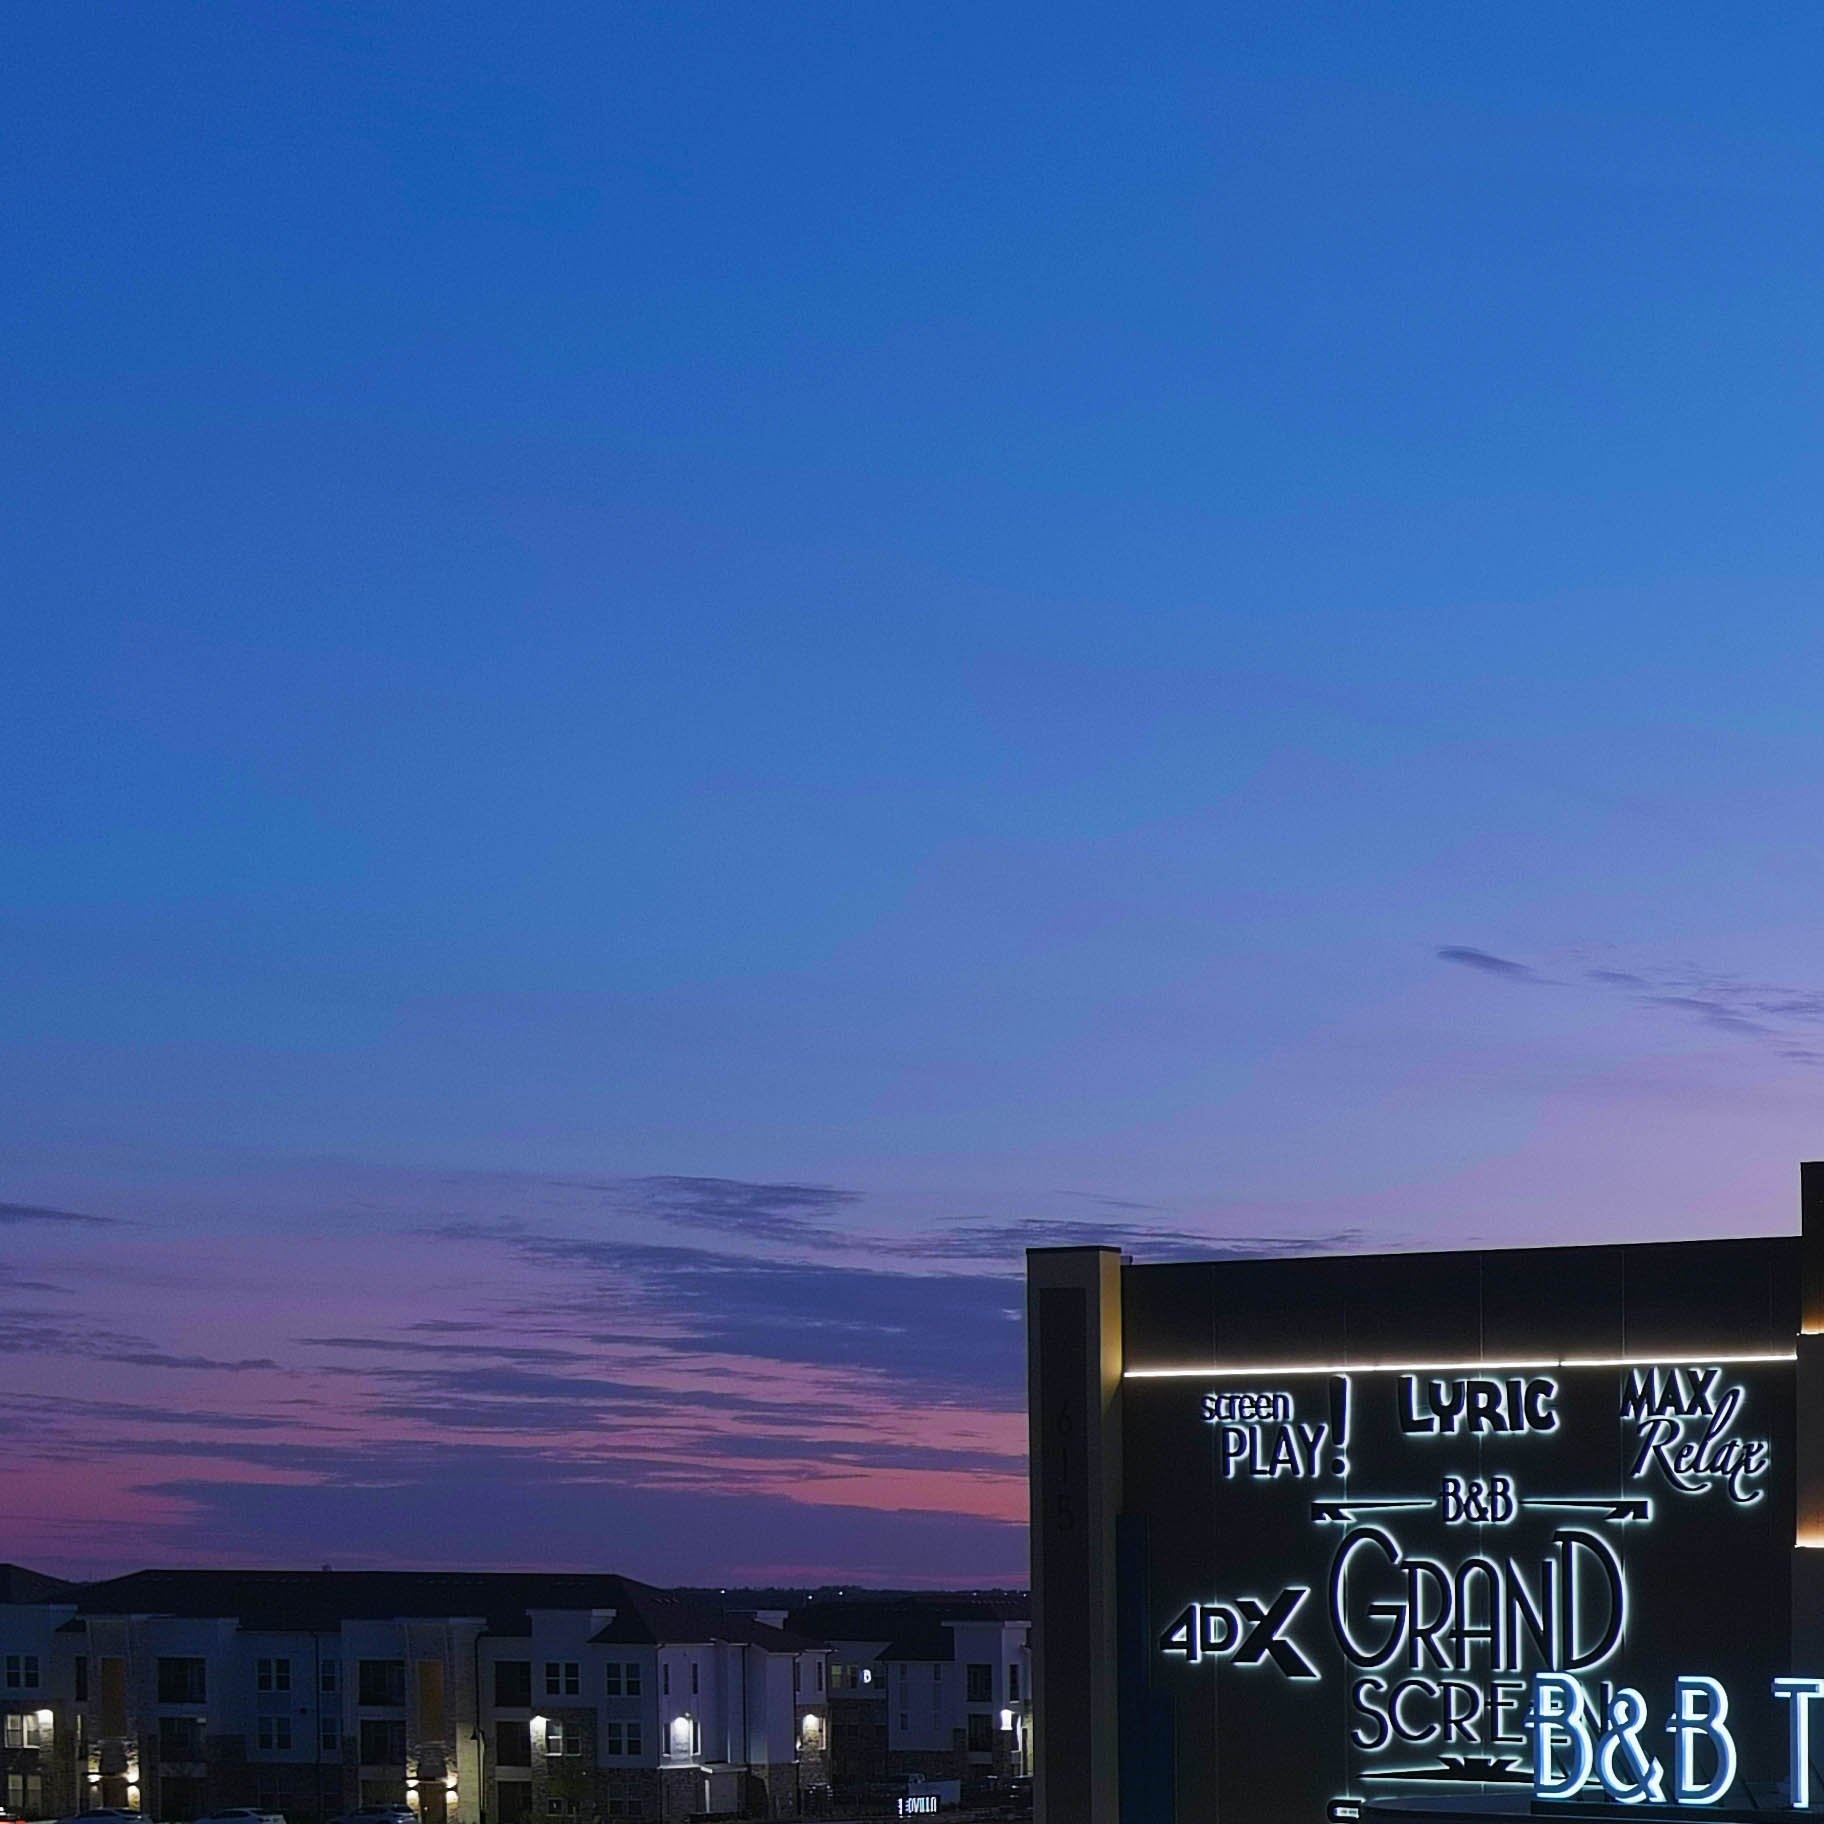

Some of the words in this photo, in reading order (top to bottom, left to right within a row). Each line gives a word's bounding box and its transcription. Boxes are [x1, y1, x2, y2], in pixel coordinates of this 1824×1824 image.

[1200, 1392, 1294, 1422] screen
[1399, 1375, 1559, 1434] LYRIC
[1619, 1366, 1722, 1423] MAX
[1630, 1386, 1770, 1507] Relax
[1438, 1476, 1515, 1524] B&B
[1160, 1586, 1321, 1681] 4DX
[1328, 1526, 1628, 1673] GRAND
[1524, 1671, 1738, 1805] B&B
